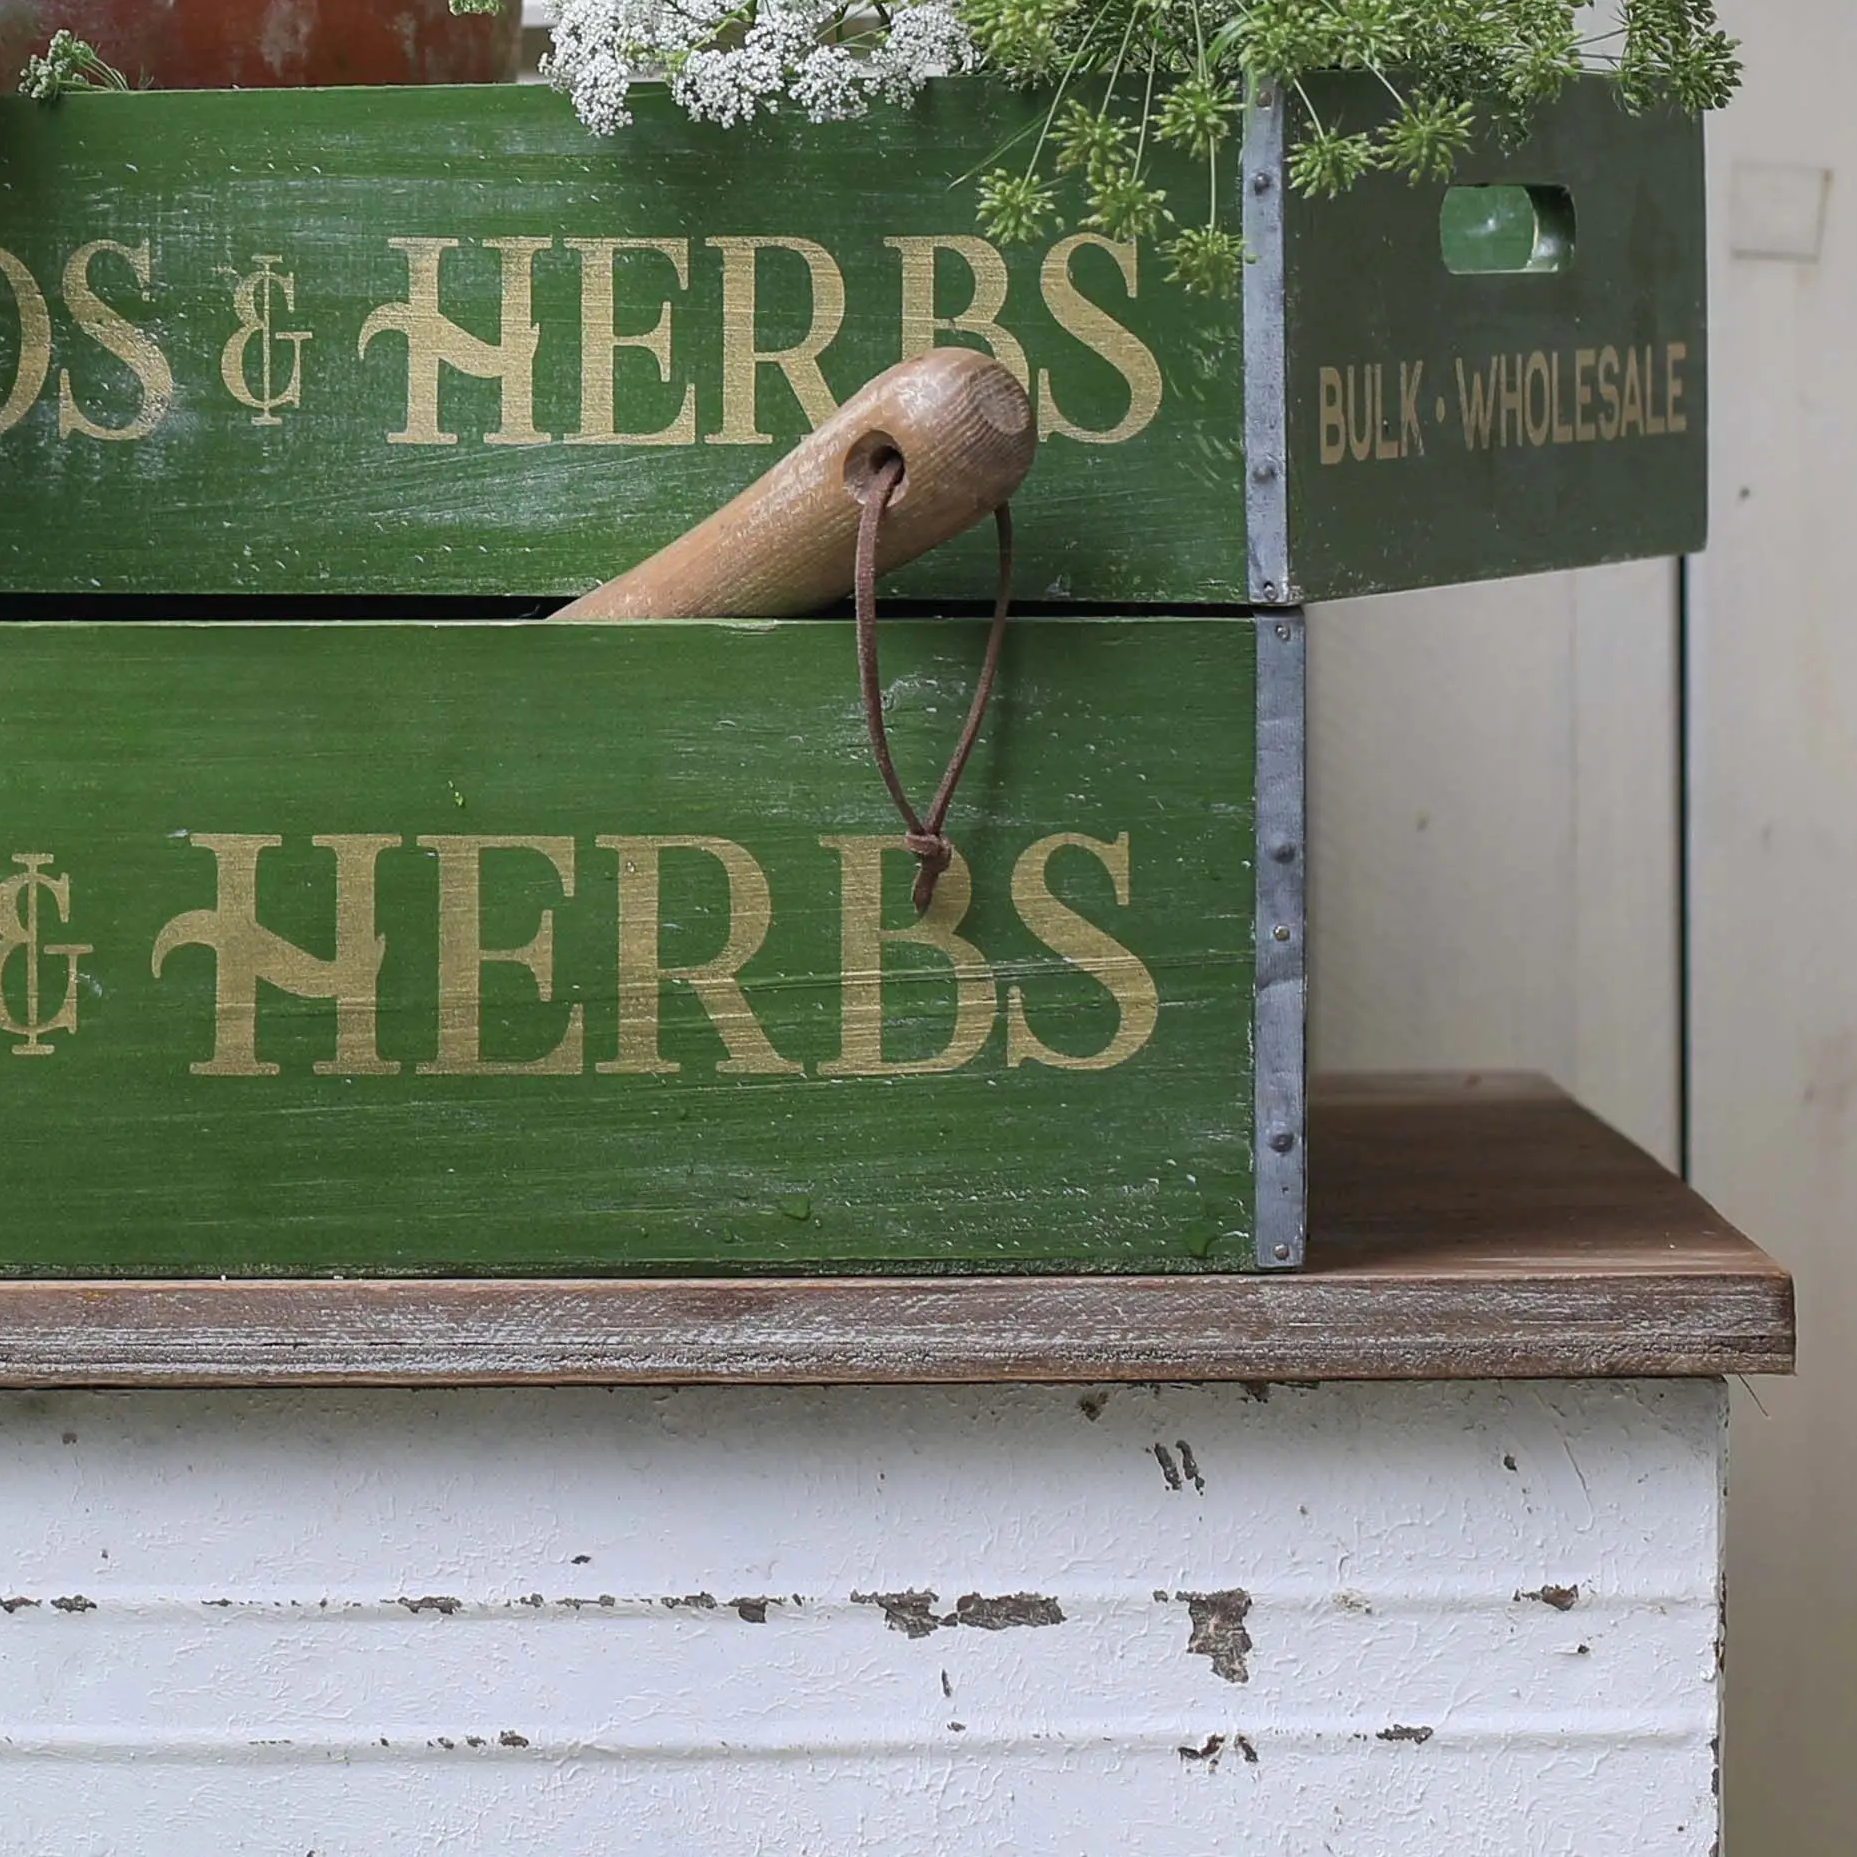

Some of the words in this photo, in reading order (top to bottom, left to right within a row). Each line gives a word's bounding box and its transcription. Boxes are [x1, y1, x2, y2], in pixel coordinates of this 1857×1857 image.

[220, 253, 313, 427] &
[1318, 358, 1427, 466] BULK
[1455, 342, 1688, 452] WHOLESALE
[150, 831, 1159, 1077] HERBS
